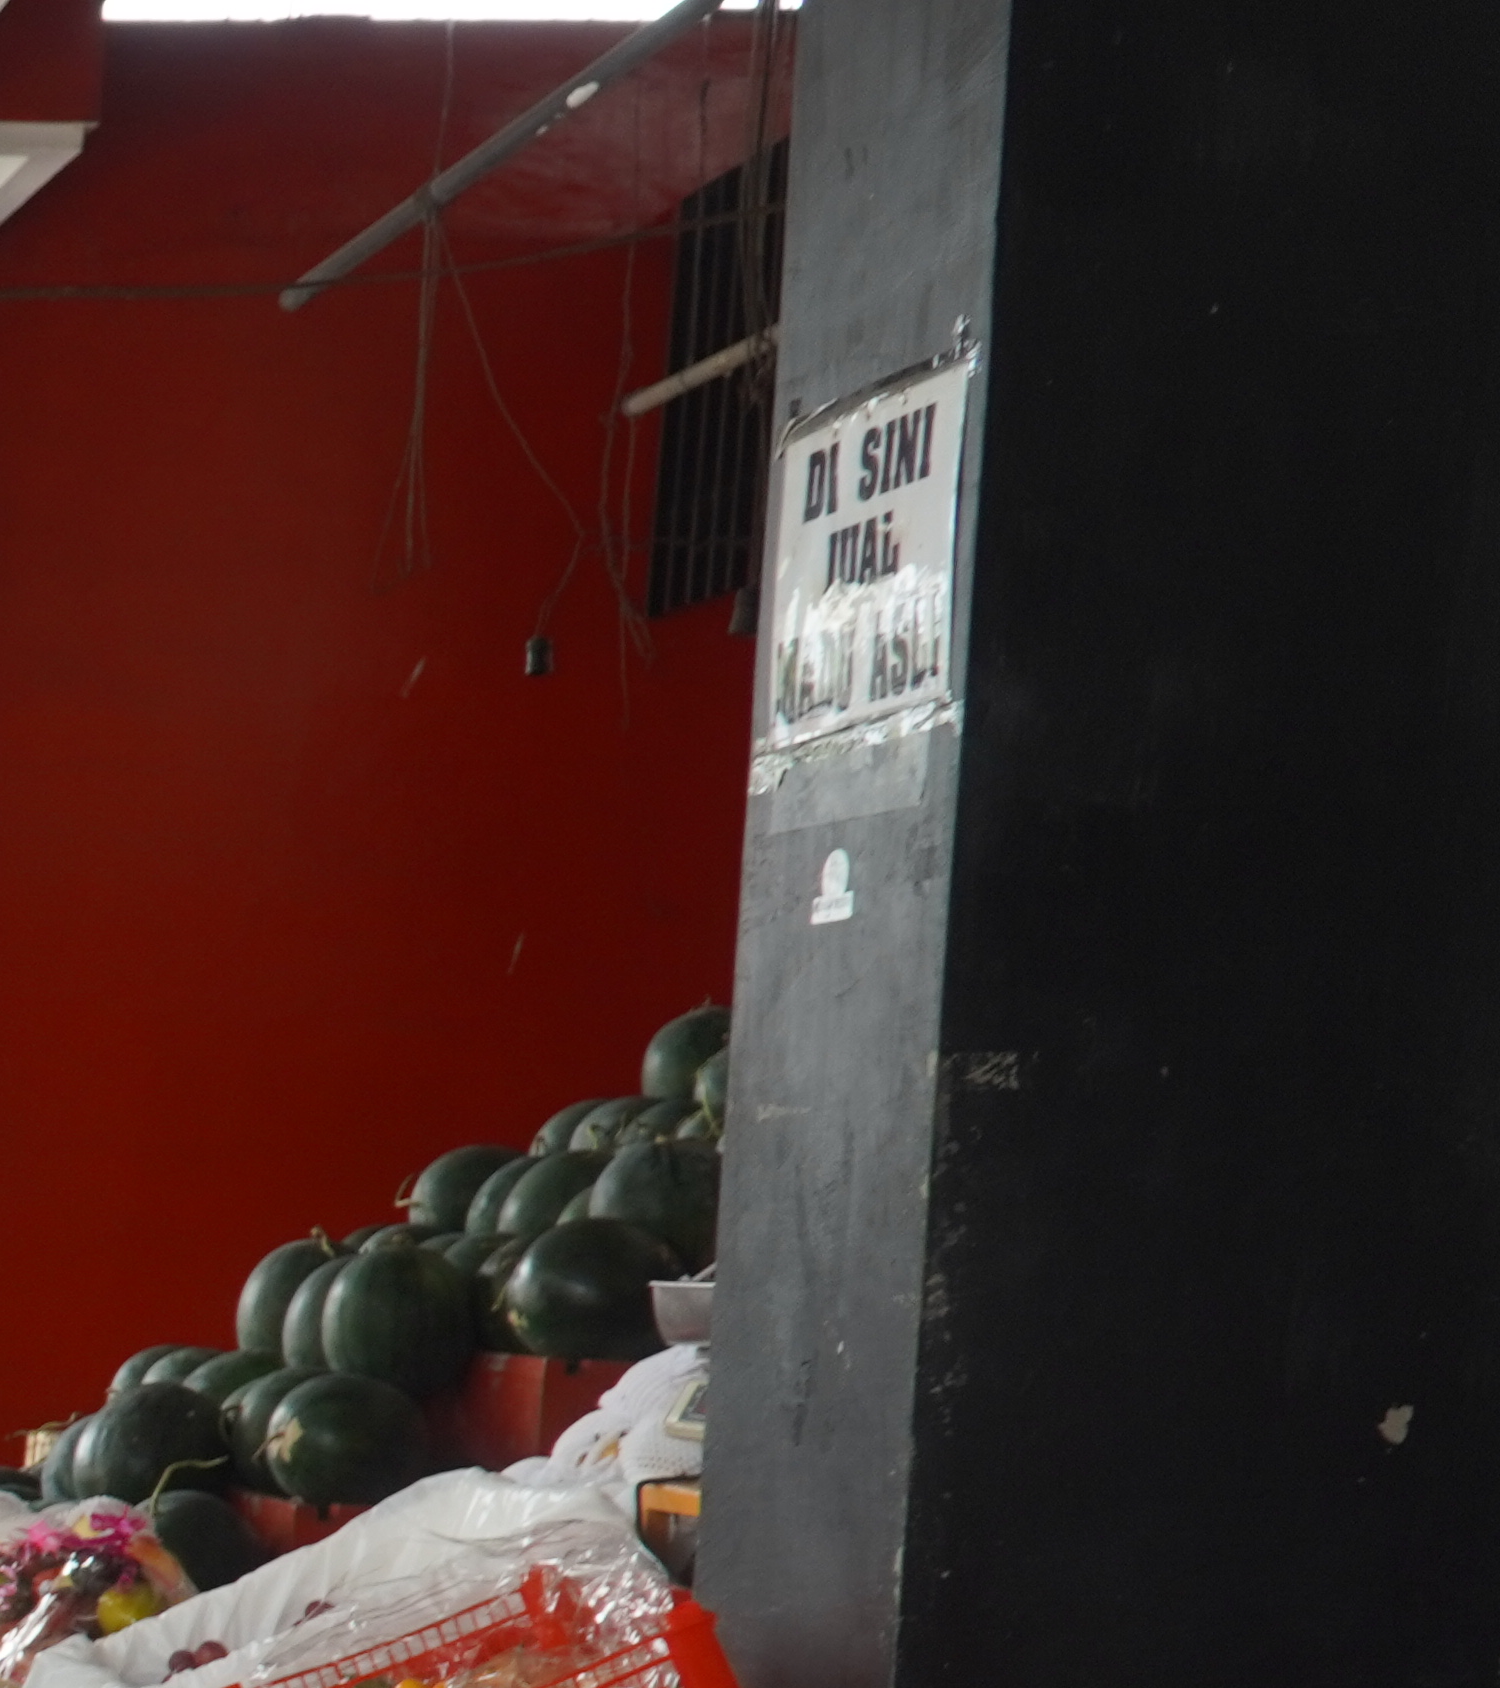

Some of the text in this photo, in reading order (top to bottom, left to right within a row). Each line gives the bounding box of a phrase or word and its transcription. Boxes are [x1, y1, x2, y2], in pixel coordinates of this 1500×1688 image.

[802, 401, 938, 524] DI SINI
[822, 508, 900, 594] JUAL
